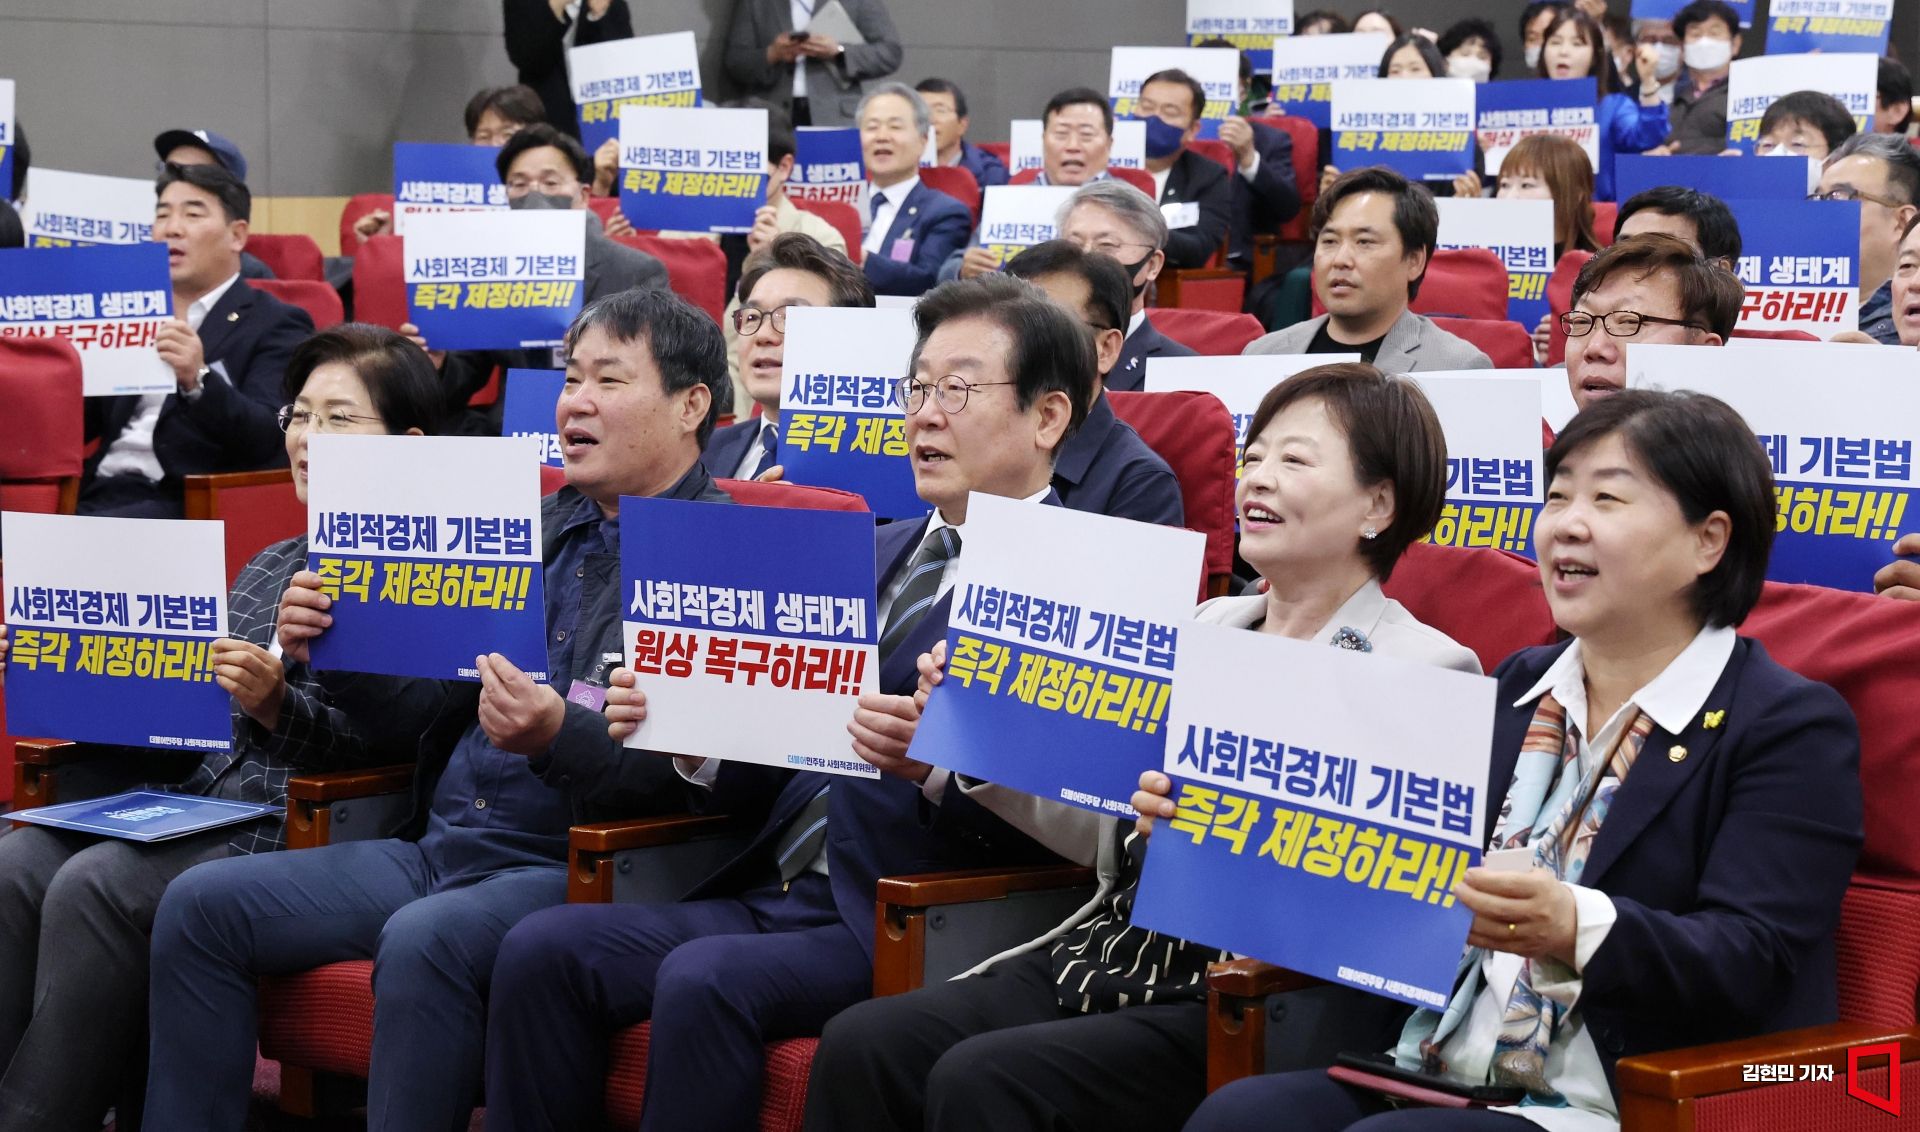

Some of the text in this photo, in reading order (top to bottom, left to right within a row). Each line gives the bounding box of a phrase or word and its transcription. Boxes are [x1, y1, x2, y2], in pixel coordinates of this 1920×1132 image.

[646, 70, 695, 90] 기본법
[1339, 112, 1469, 128] 사회적경제 기본법
[624, 147, 761, 169] 사회적경제 기본법
[1338, 131, 1378, 151] 즉각
[399, 181, 484, 205] 사회적경제
[624, 170, 661, 194] 즉각
[663, 173, 762, 198] 제정하라!!
[34, 212, 113, 239] 사회적경제
[413, 255, 577, 279] 사회적경제 기본법
[1769, 255, 1851, 285] 생태계
[100, 290, 167, 317] 생태계
[414, 281, 577, 310] 즉각 제정하라!!
[785, 413, 848, 453] 즉각
[1446, 457, 1533, 497] 기본법
[1799, 436, 1912, 481] 기본법
[315, 511, 532, 556] 사회적경제 기본법
[1420, 503, 1533, 551] 하라!!
[318, 557, 532, 611] 즉각 제정하라!!
[10, 586, 218, 632] 사회적경제 기본법
[630, 578, 867, 639] 사회적경제 생태계
[957, 583, 1178, 671] 사회적경제 기본법
[12, 629, 215, 683] 즉각 제정하라!!
[633, 629, 867, 696] 원상 복구하라!!
[947, 635, 1172, 735] 즉각 제정하라!!
[787, 755, 878, 774] 더불어민주당 사회적경제위원회
[1177, 724, 1475, 836] 사회적경제 기본법
[1169, 783, 1470, 909] 즉각 제정하라!!
